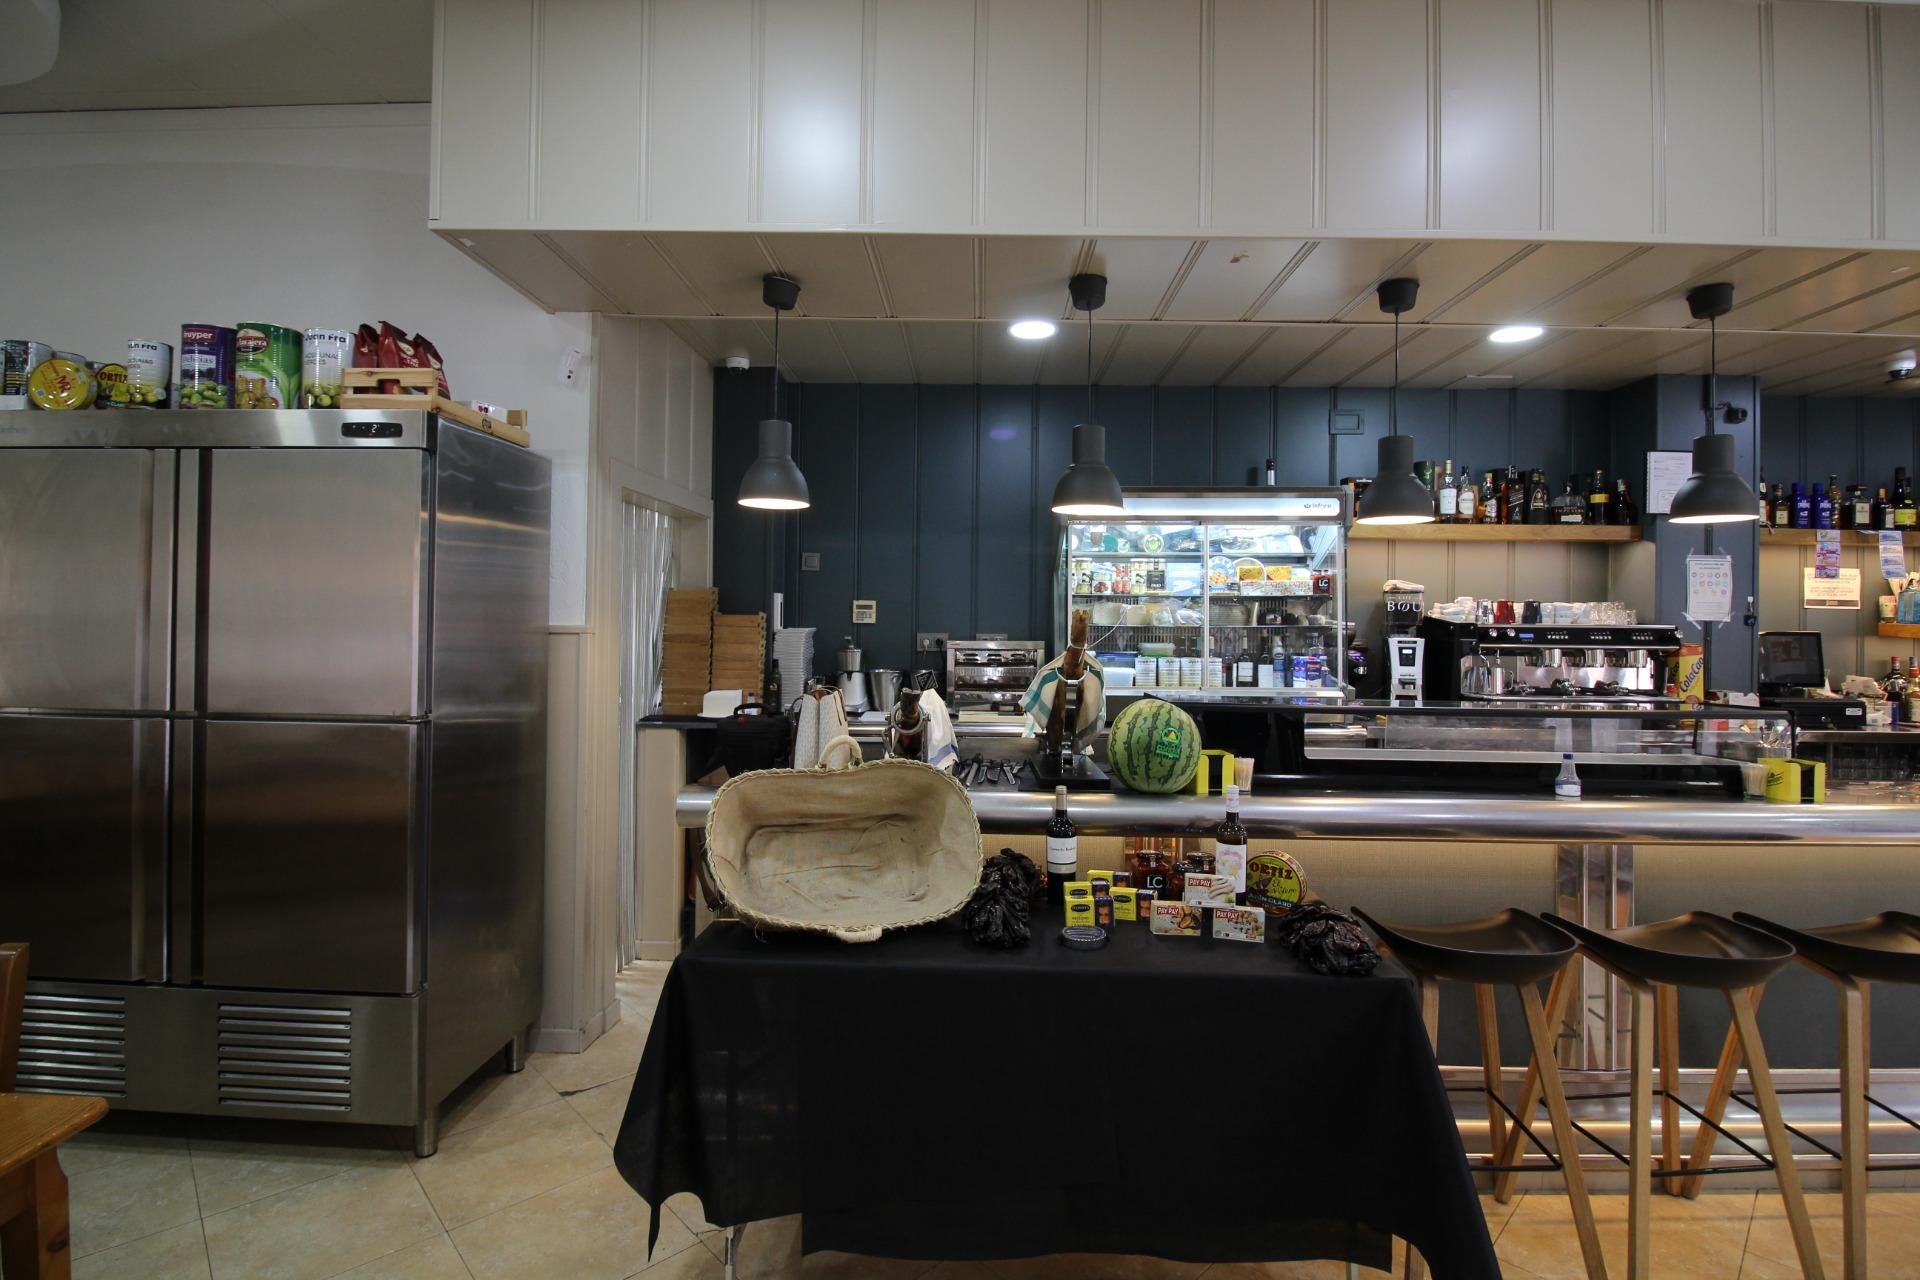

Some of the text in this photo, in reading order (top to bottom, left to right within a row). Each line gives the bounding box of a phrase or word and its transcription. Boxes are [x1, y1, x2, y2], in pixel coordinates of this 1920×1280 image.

[1249, 861, 1293, 880] ORTIZ
[1146, 876, 1164, 889] LC
[1200, 879, 1211, 887] PAY
[1168, 907, 1179, 915] PAY
[1216, 910, 1239, 919] PAY PAY
